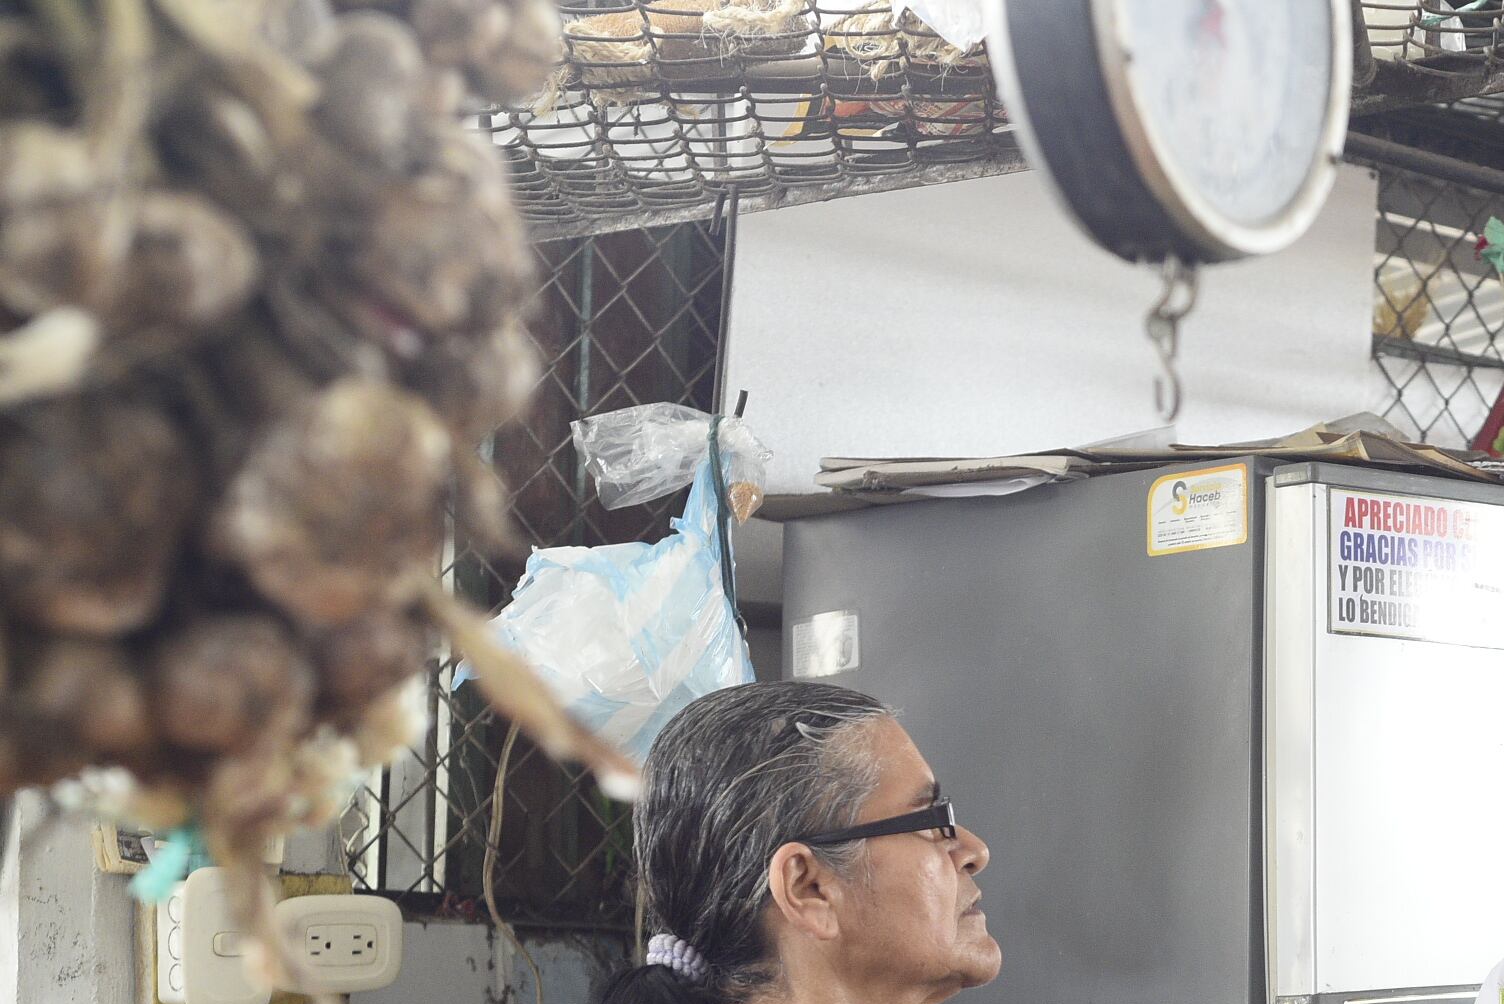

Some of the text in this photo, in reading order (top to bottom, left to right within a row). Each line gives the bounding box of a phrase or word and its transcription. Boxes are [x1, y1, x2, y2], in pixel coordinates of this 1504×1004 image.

[1188, 490, 1221, 505] Haceb
[1344, 496, 1448, 538] APRECIADO
[1339, 530, 1418, 568] GRACIAS
[1423, 539, 1457, 572] POR
[1338, 564, 1348, 592] Y
[1352, 565, 1385, 596] POR
[1338, 597, 1356, 623] LO
